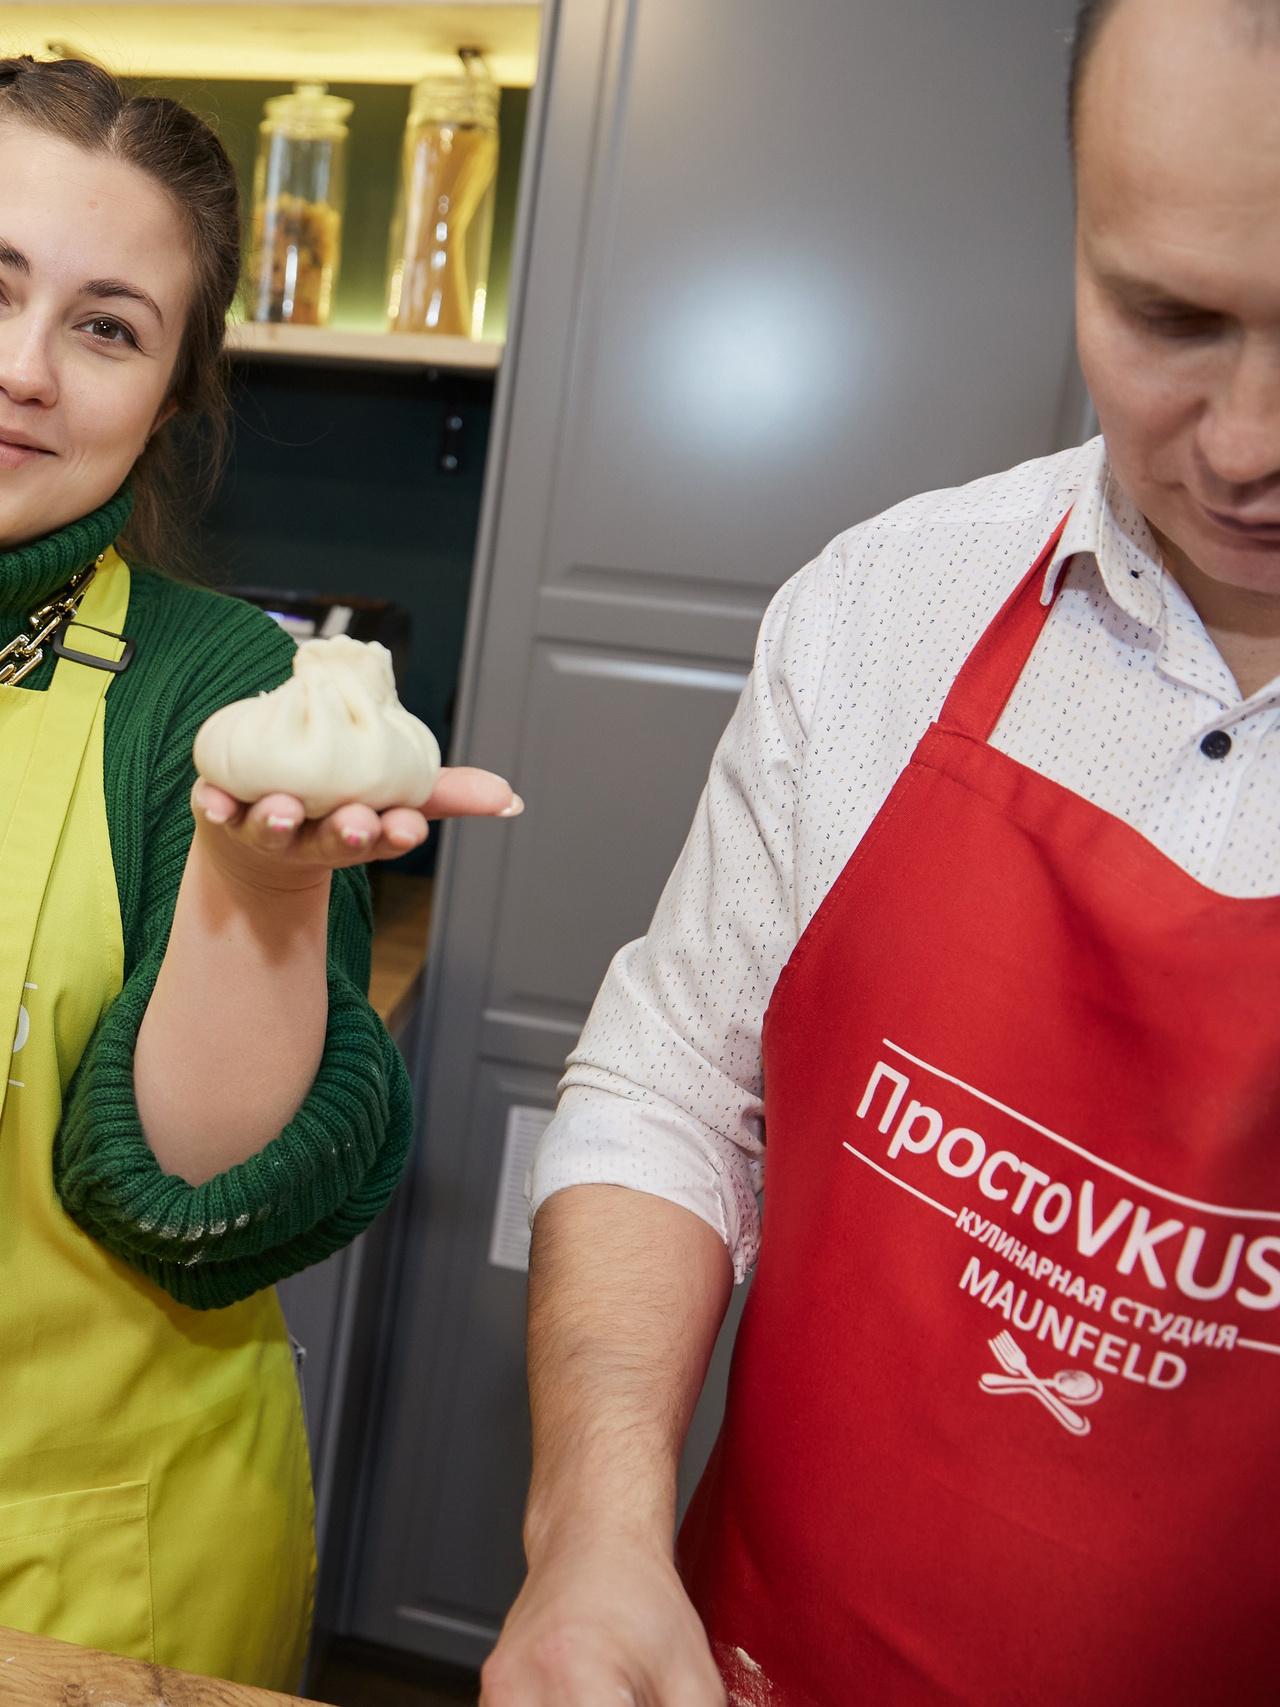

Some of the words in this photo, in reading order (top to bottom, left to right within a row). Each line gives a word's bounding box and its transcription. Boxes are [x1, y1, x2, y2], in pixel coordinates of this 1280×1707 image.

[955, 1206, 1108, 1312] КУЛИНАРНАЯ
[1110, 1296, 1239, 1352] СТУДИЯ
[958, 1256, 1188, 1391] MAUNFELD
